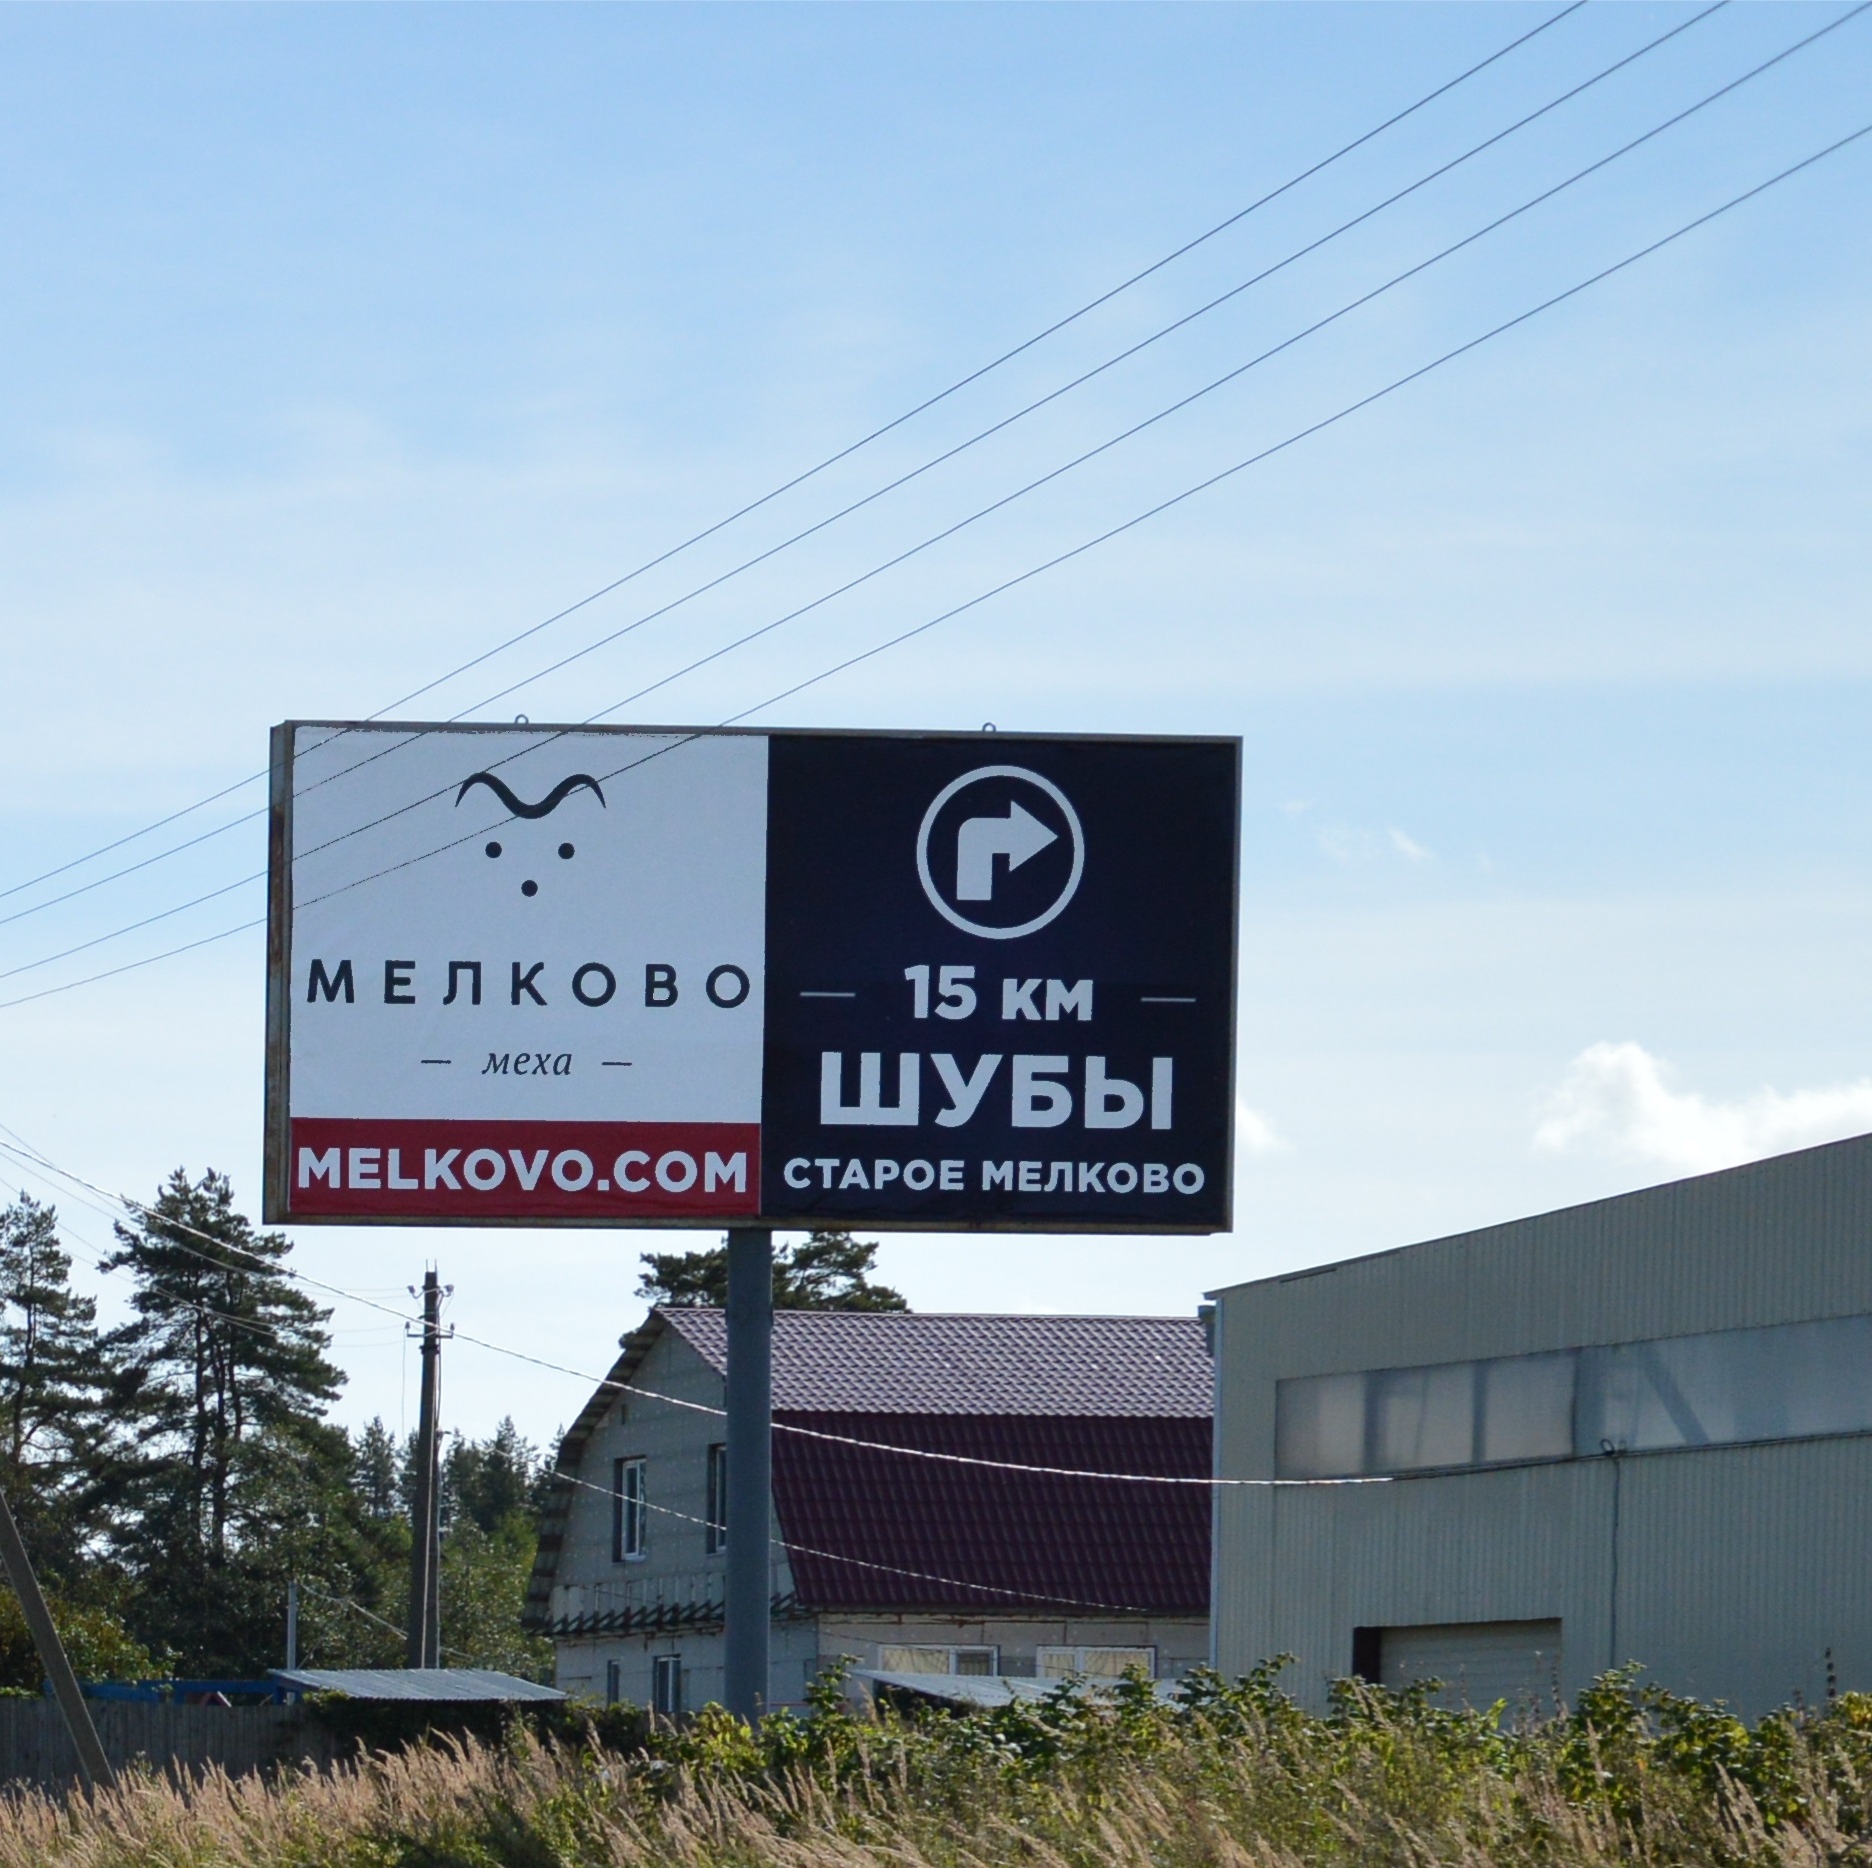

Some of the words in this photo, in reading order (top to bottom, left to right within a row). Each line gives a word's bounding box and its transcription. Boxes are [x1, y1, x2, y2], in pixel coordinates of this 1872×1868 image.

[306, 958, 751, 1009] МЕЛКОВО
[904, 964, 978, 1020] 15
[481, 1051, 573, 1076] меха
[820, 1051, 1173, 1130] ШУБЫ
[298, 1147, 747, 1193] MELKOVO.COM
[783, 1157, 965, 1191] СТАРОЕ
[981, 1160, 1205, 1195] МЕЛКОВО
